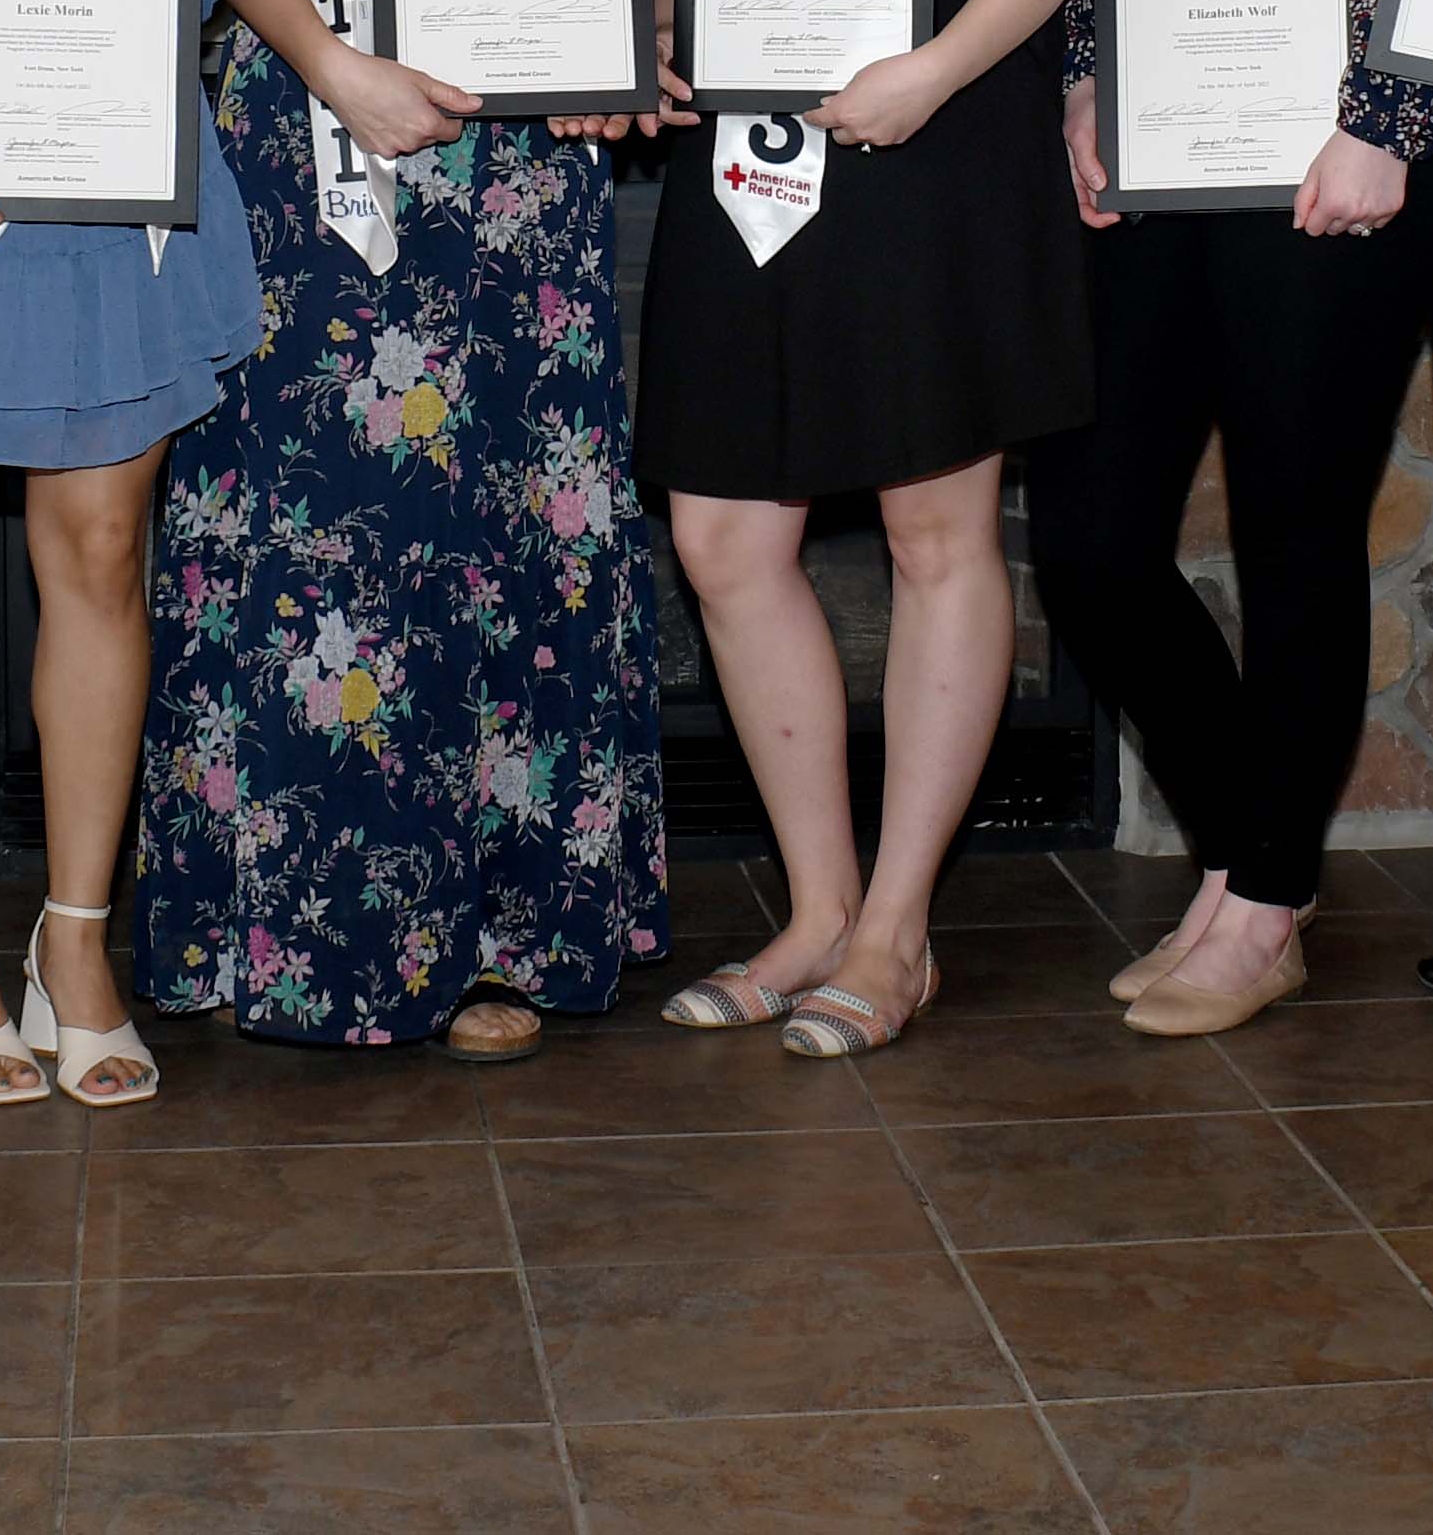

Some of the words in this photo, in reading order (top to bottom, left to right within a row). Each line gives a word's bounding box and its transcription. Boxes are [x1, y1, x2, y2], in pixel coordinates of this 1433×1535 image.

[17, 3, 51, 16] Lexie
[54, 4, 93, 16] Morin
[1188, 7, 1243, 20] Elizabeth
[1247, 5, 1278, 17] Wolf
[749, 169, 811, 192] American
[748, 182, 773, 197] Red
[775, 188, 810, 206] Cross
